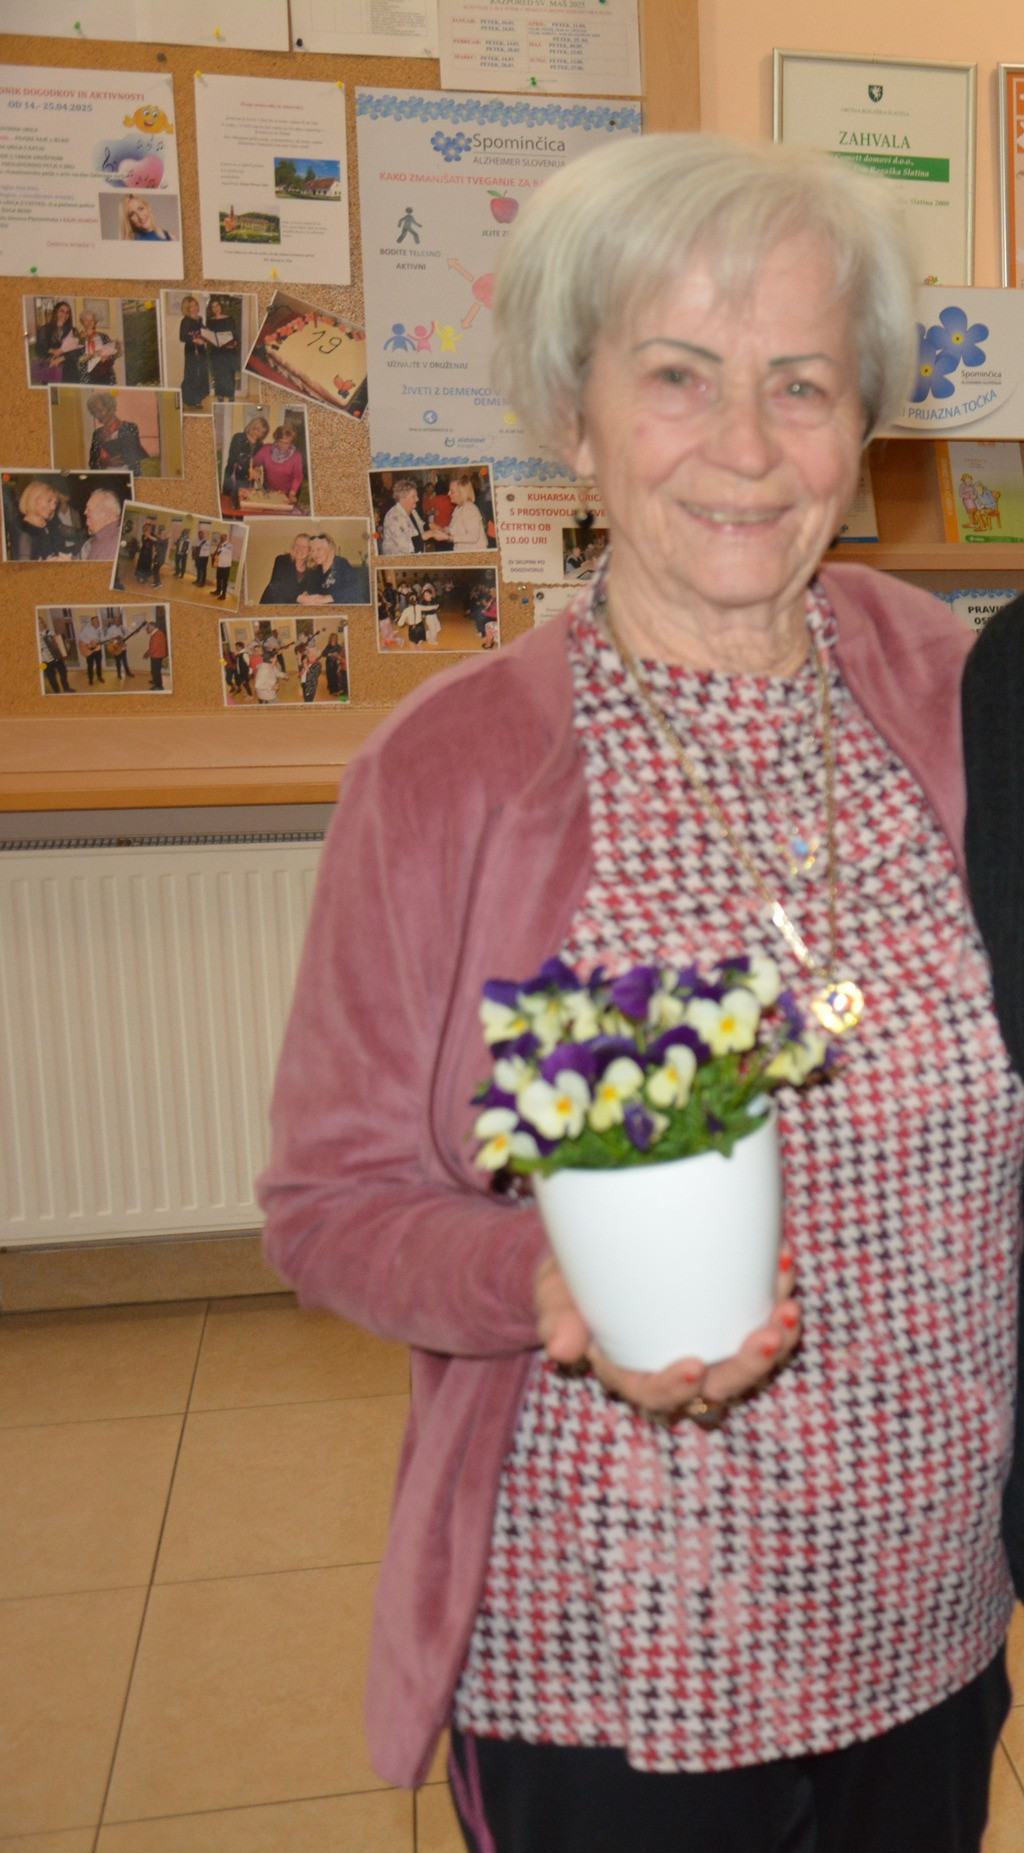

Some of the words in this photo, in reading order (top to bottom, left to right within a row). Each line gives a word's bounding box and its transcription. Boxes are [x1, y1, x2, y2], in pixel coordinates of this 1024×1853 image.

[23, 87, 76, 98] DOGODKOV
[90, 91, 145, 101] AKTIVNOSTI
[472, 133, 566, 152] Spominčica
[838, 130, 911, 149] ZAHVALA
[473, 156, 521, 166] ALZHEIMER
[863, 154, 892, 164] domovi
[902, 169, 930, 178] Slatina
[379, 172, 407, 182] KAKO
[409, 172, 464, 184] ZMANJŠATI
[467, 176, 515, 187] TVEGANJE
[518, 178, 530, 187] ZA
[379, 248, 407, 257] BODITE
[396, 263, 427, 271] AKTIVNI
[306, 330, 343, 355] 19
[960, 370, 1002, 379] Spominčica
[402, 384, 432, 395] ŽIVETI
[434, 387, 440, 395] Z
[442, 387, 492, 397] DEMENCO
[908, 406, 961, 420] PRIJAZNA
[962, 388, 998, 414] TOČKA
[527, 493, 576, 502] KUHARSKA
[509, 508, 515, 517] S
[500, 522, 536, 531] ČETRTKI
[538, 523, 551, 532] OB
[505, 536, 529, 545] 10.00
[531, 536, 547, 545] URI
